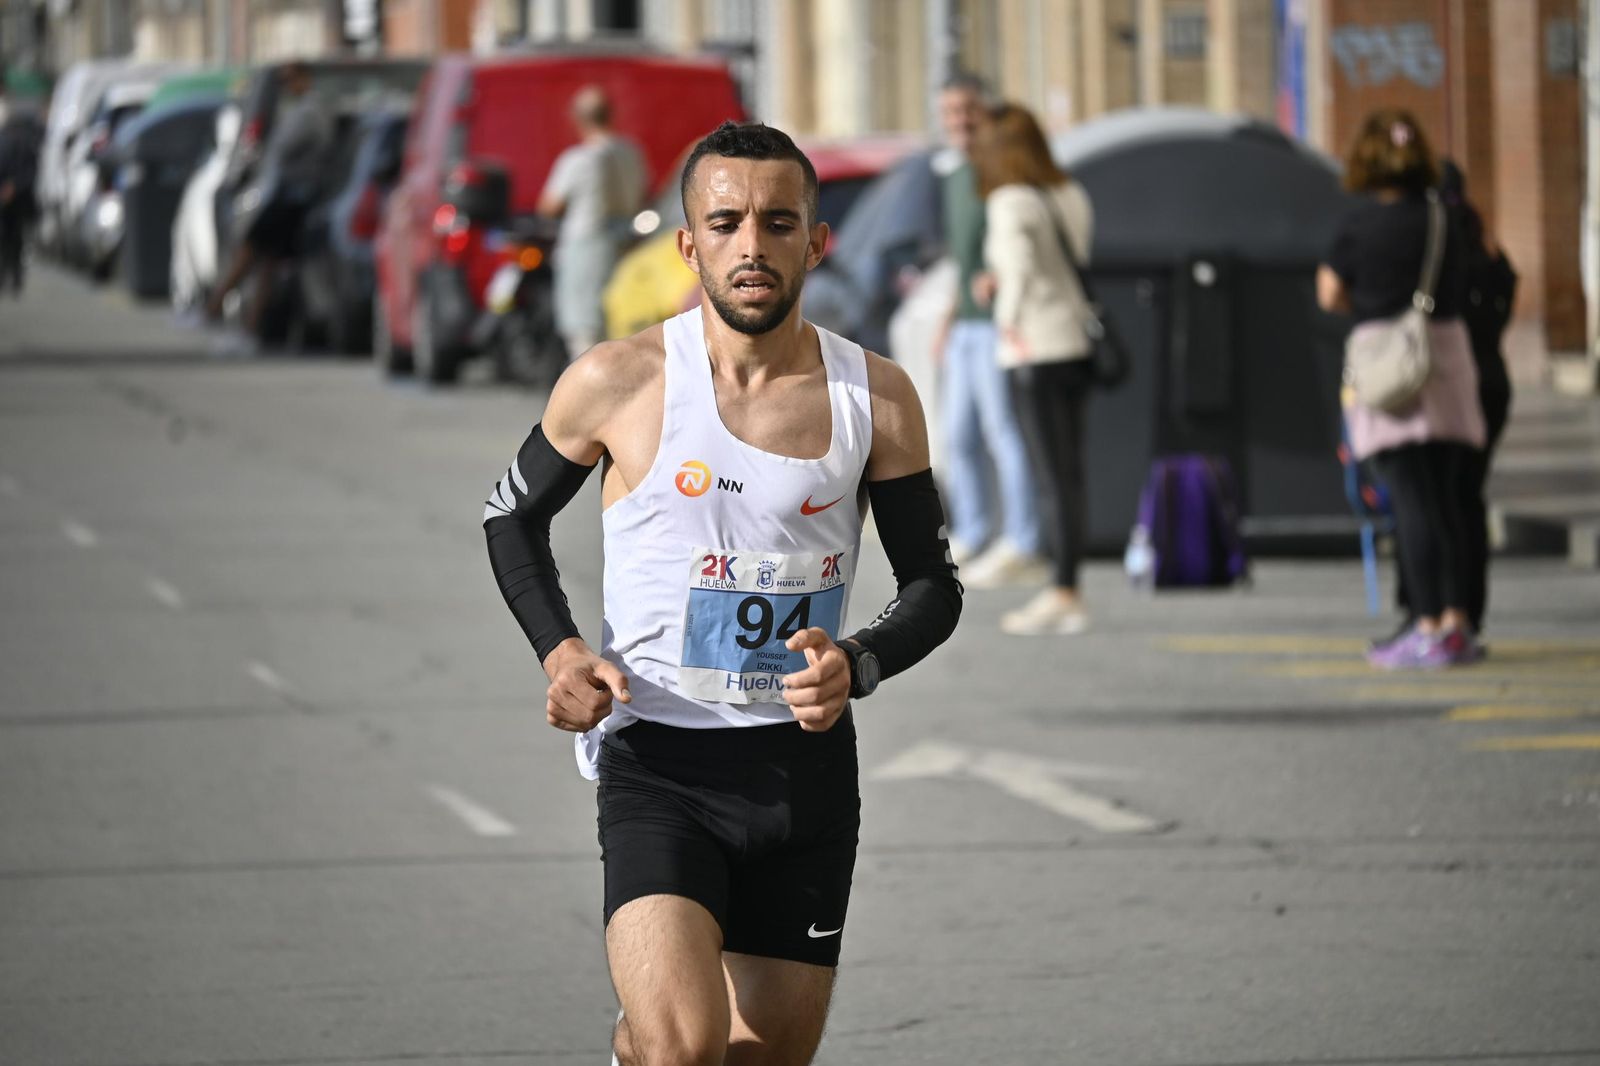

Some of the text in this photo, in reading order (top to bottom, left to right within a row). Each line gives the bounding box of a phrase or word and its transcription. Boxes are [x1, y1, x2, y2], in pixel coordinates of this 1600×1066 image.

[717, 477, 744, 494] NN
[701, 554, 739, 581] 21K
[821, 552, 845, 578] 21K
[699, 578, 737, 590] HUELVA
[776, 580, 806, 588] HUELVA
[820, 576, 842, 590] HUELVA
[735, 595, 812, 650] 94
[756, 652, 788, 661] YOUSSEF
[756, 664, 783, 672] IZIKKI
[726, 673, 791, 691] Huelv
